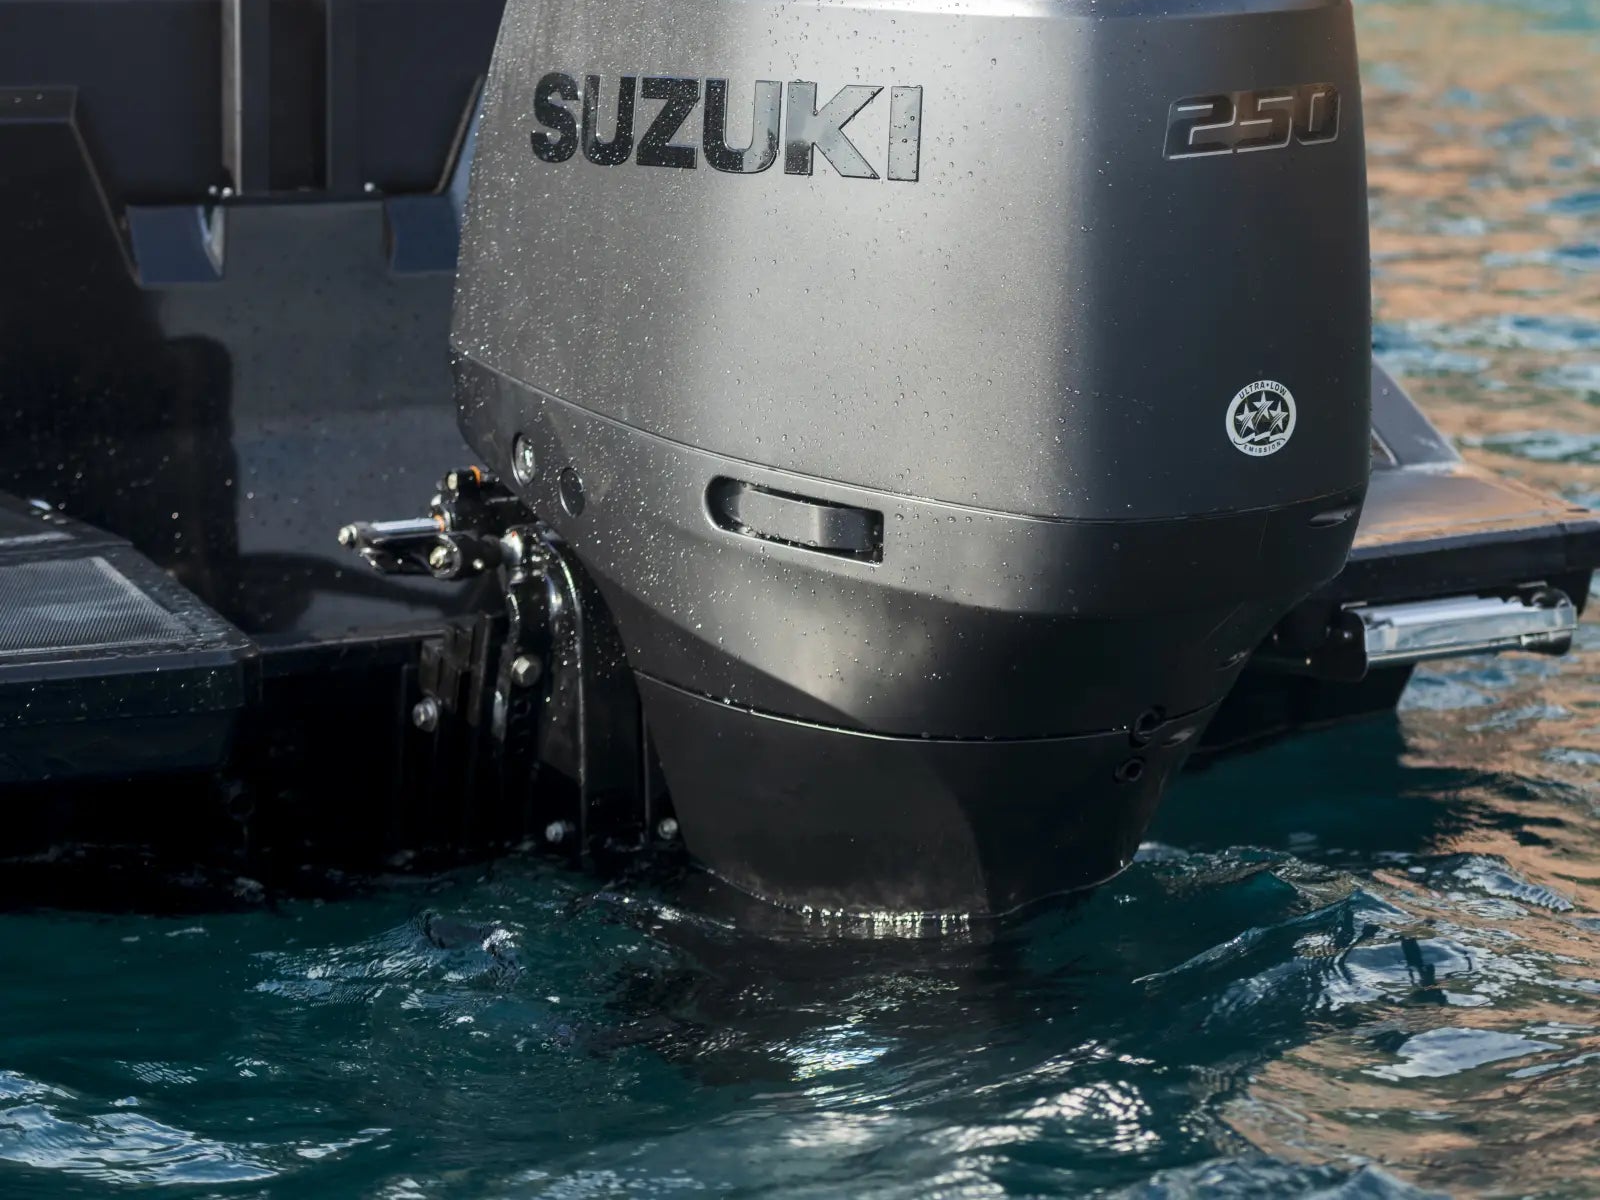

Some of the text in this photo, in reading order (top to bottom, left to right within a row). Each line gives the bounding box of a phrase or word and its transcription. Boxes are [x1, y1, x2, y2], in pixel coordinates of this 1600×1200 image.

[530, 72, 922, 182] SUZUKI
[1162, 82, 1340, 159] 250
[1243, 441, 1282, 453] EMISSION
